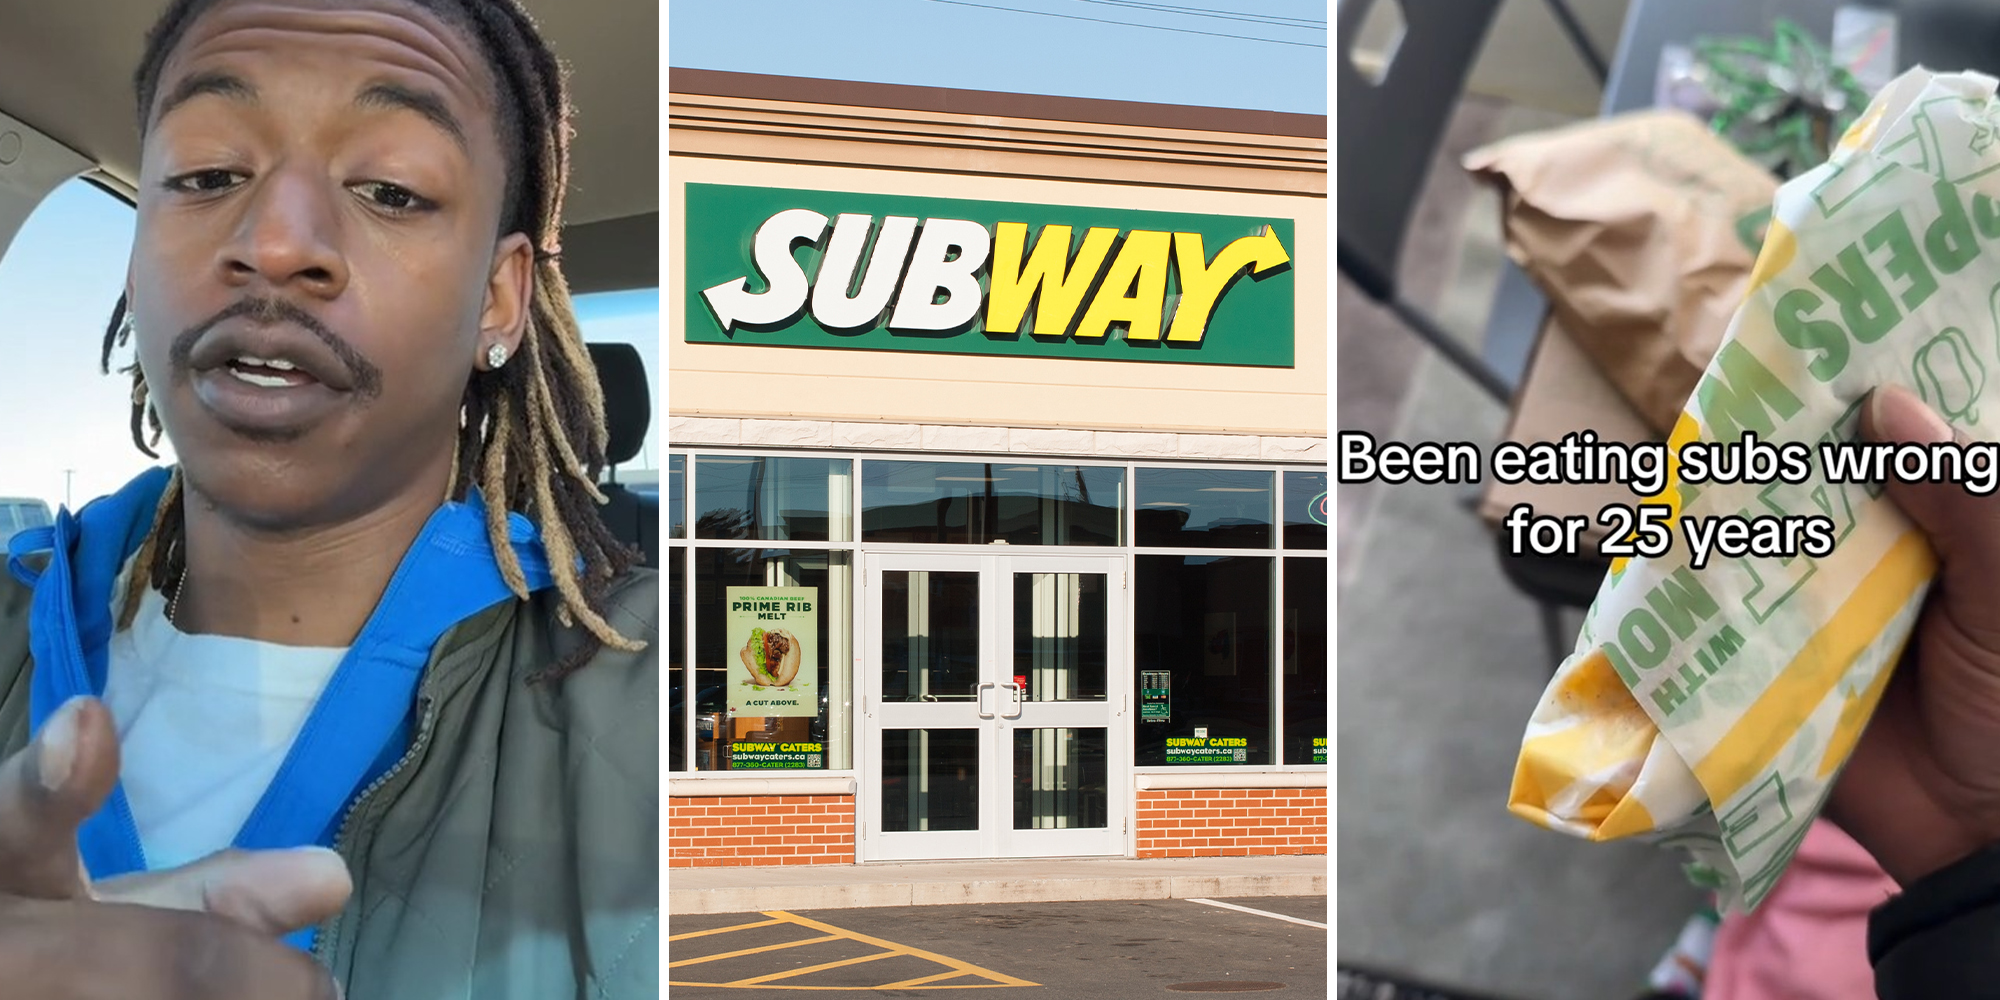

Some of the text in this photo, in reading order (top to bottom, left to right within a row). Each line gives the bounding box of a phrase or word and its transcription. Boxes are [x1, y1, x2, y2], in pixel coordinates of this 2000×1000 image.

[700, 208, 1291, 342] SUBWAY
[732, 602, 812, 612] PRIME RIB
[1650, 624, 1746, 717] WITH
[732, 742, 823, 752] SUBWAY CATERS
[1166, 737, 1248, 747] SUBWAY CATERS
[1166, 747, 1233, 756] subwaycaters.ca
[732, 753, 806, 761] subwaycaters.ca
